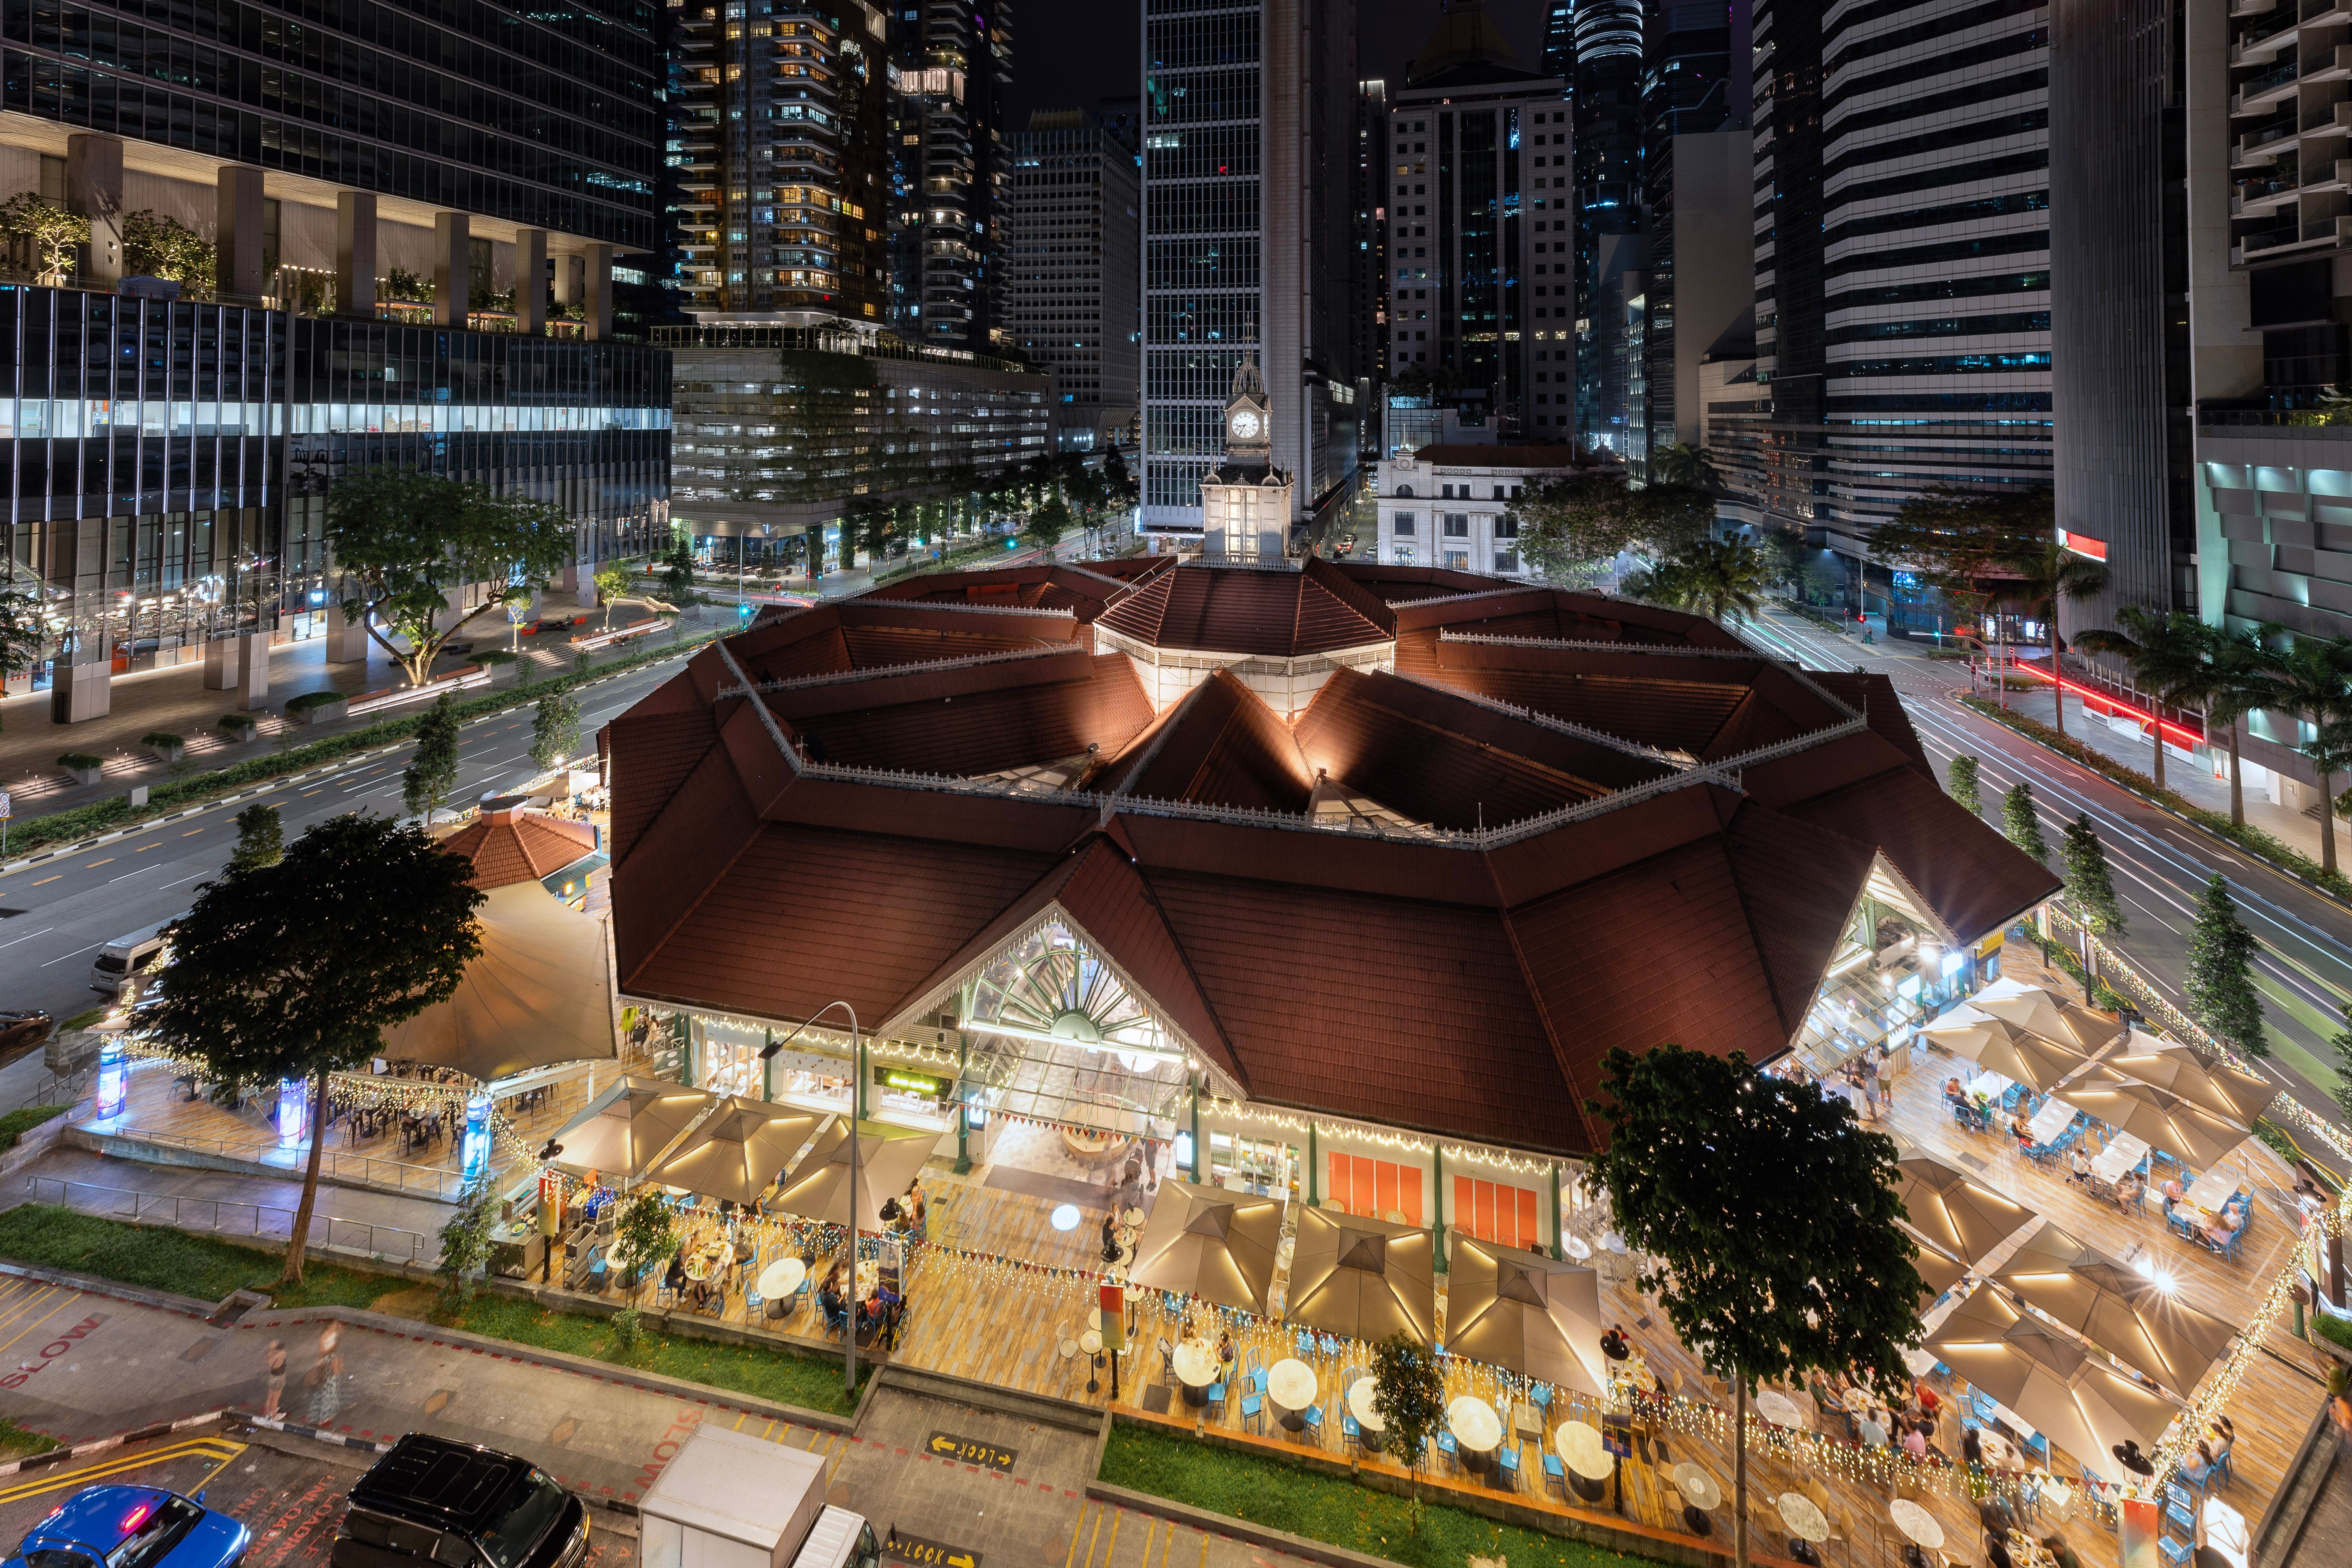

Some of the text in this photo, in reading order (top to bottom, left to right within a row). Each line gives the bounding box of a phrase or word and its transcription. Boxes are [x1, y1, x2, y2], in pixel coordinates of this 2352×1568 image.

[0, 1318, 100, 1389] SLOW
[633, 1407, 704, 1490] SLOW
[958, 1442, 996, 1463] LOOK
[229, 1487, 268, 1517] ONL
[246, 1475, 336, 1561] UNLOADIN
[264, 1492, 343, 1567] LOADING
[904, 1541, 945, 1565] LOOK
